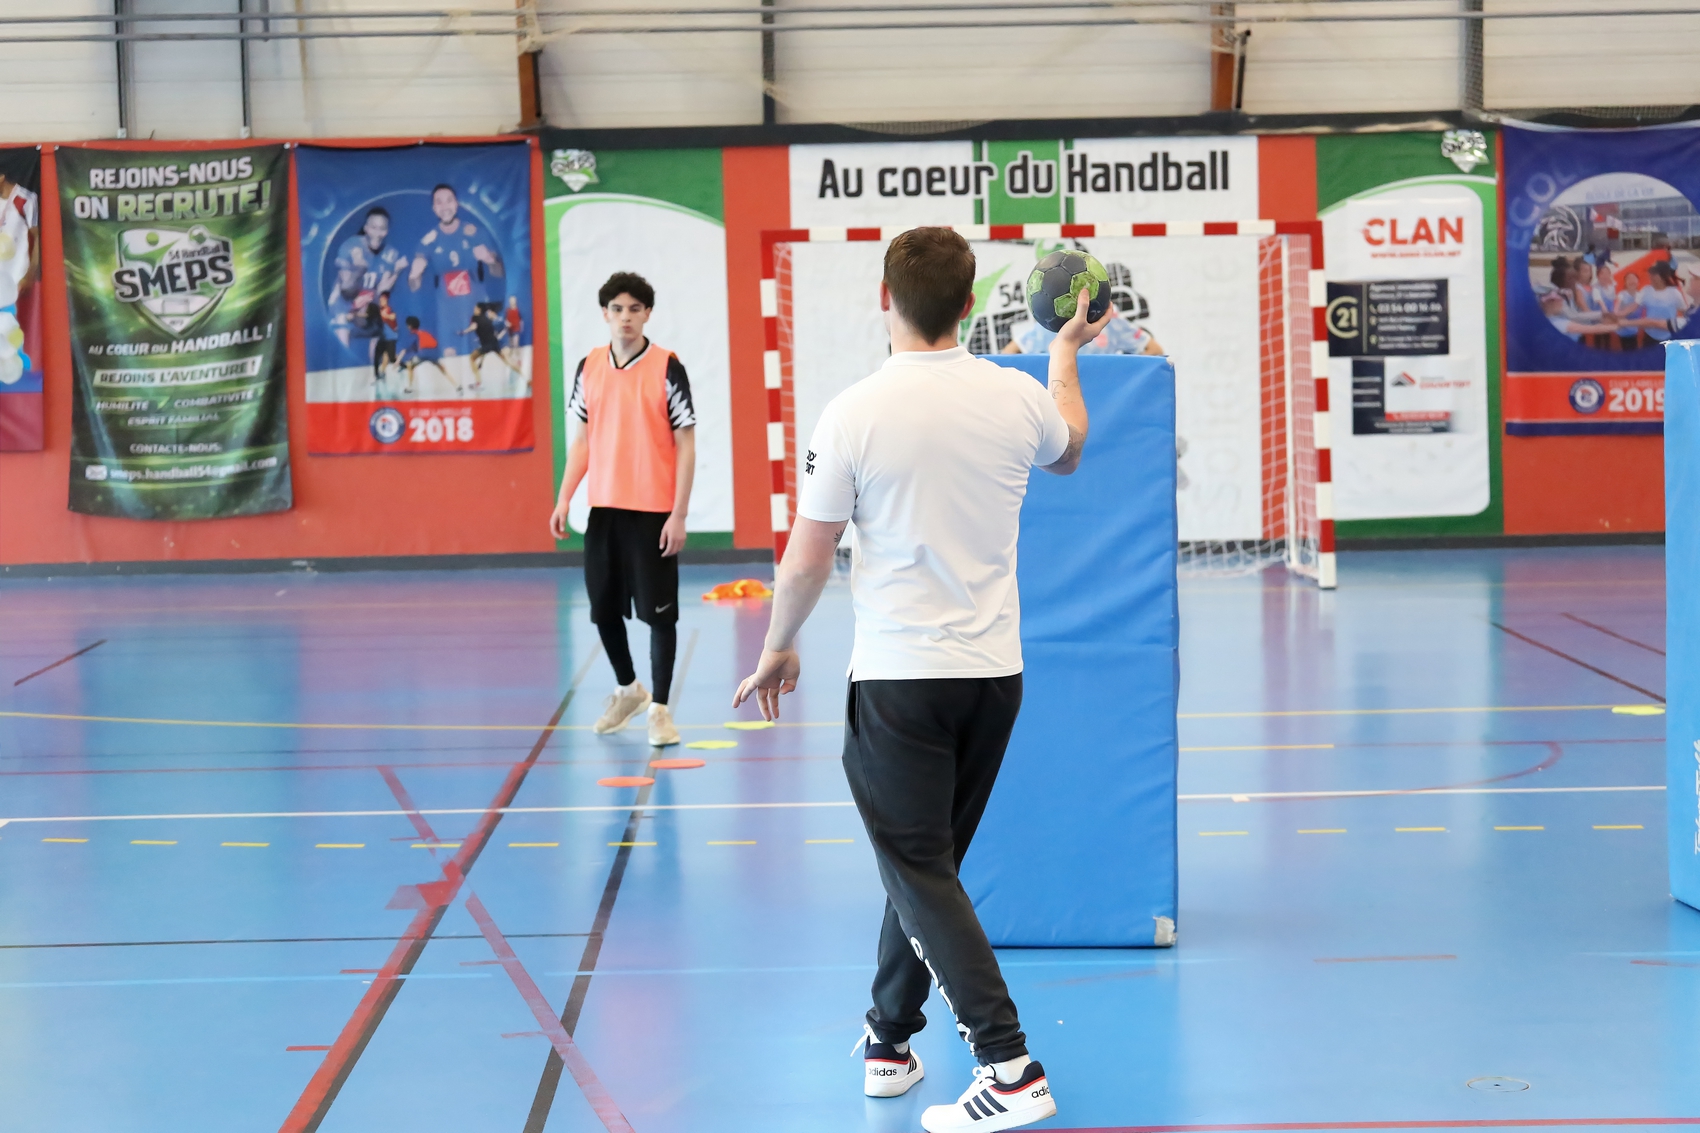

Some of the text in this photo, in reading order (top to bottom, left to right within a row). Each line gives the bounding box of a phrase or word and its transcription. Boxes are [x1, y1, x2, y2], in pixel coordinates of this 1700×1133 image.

[89, 156, 253, 189] REJOINS-NOUS
[818, 151, 1229, 198] Au coeur du Handball
[74, 196, 109, 219] ON
[117, 180, 271, 222] RECRUTE!
[1361, 216, 1464, 246] CLAN
[114, 255, 233, 299] SMEPS
[1000, 281, 1024, 307] 54
[1337, 307, 1358, 328] 21
[88, 344, 103, 355] AU
[106, 342, 149, 356] COEUR
[171, 326, 263, 354] HANDBALL
[100, 372, 155, 384] REJOINS
[160, 361, 248, 383] L'AVENTURE
[1608, 387, 1665, 412] 2019
[409, 416, 474, 443] 2018
[868, 1067, 897, 1077] adidas
